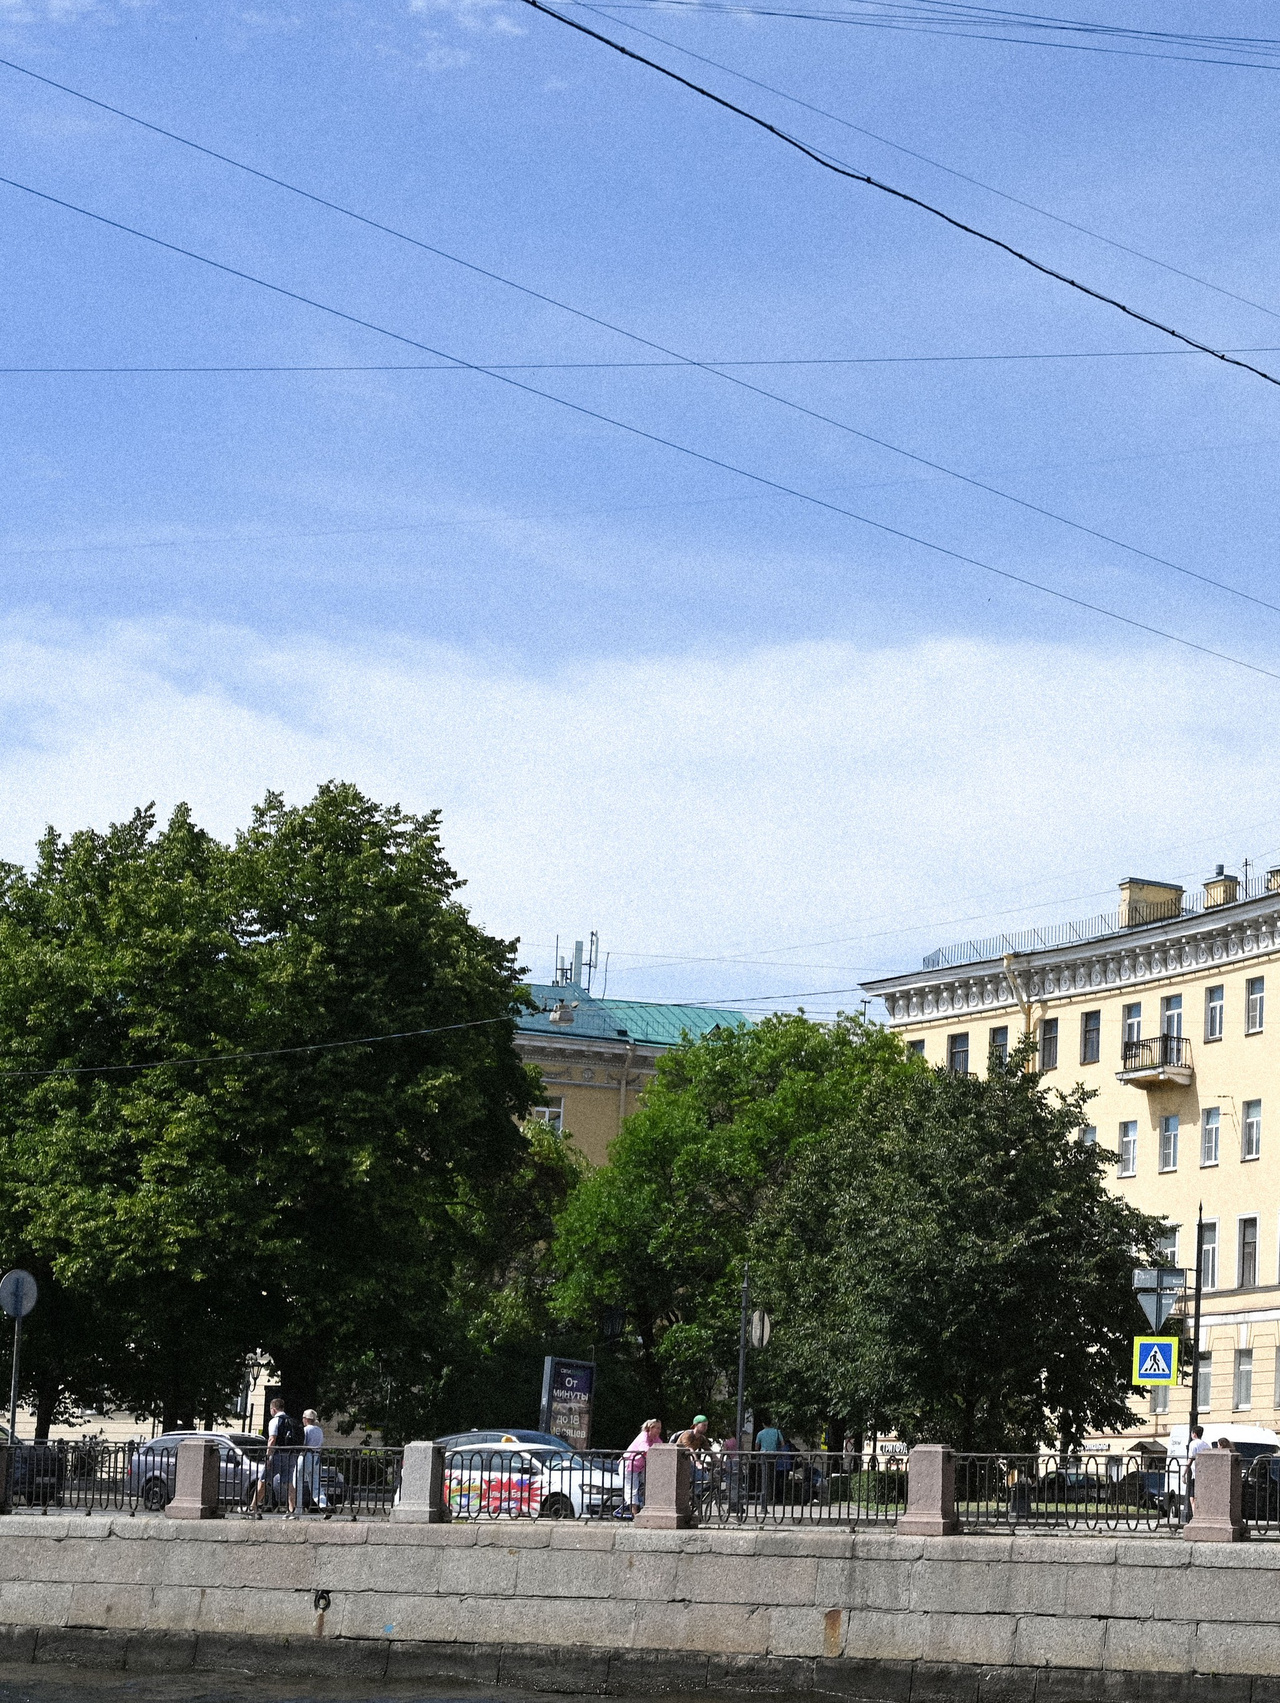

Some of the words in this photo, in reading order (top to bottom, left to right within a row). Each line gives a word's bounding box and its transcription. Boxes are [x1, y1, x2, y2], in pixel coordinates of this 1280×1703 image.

[565, 1377, 578, 1388] От
[553, 1388, 589, 1401] минуты
[556, 1414, 569, 1425] до
[570, 1414, 580, 1425] 18
